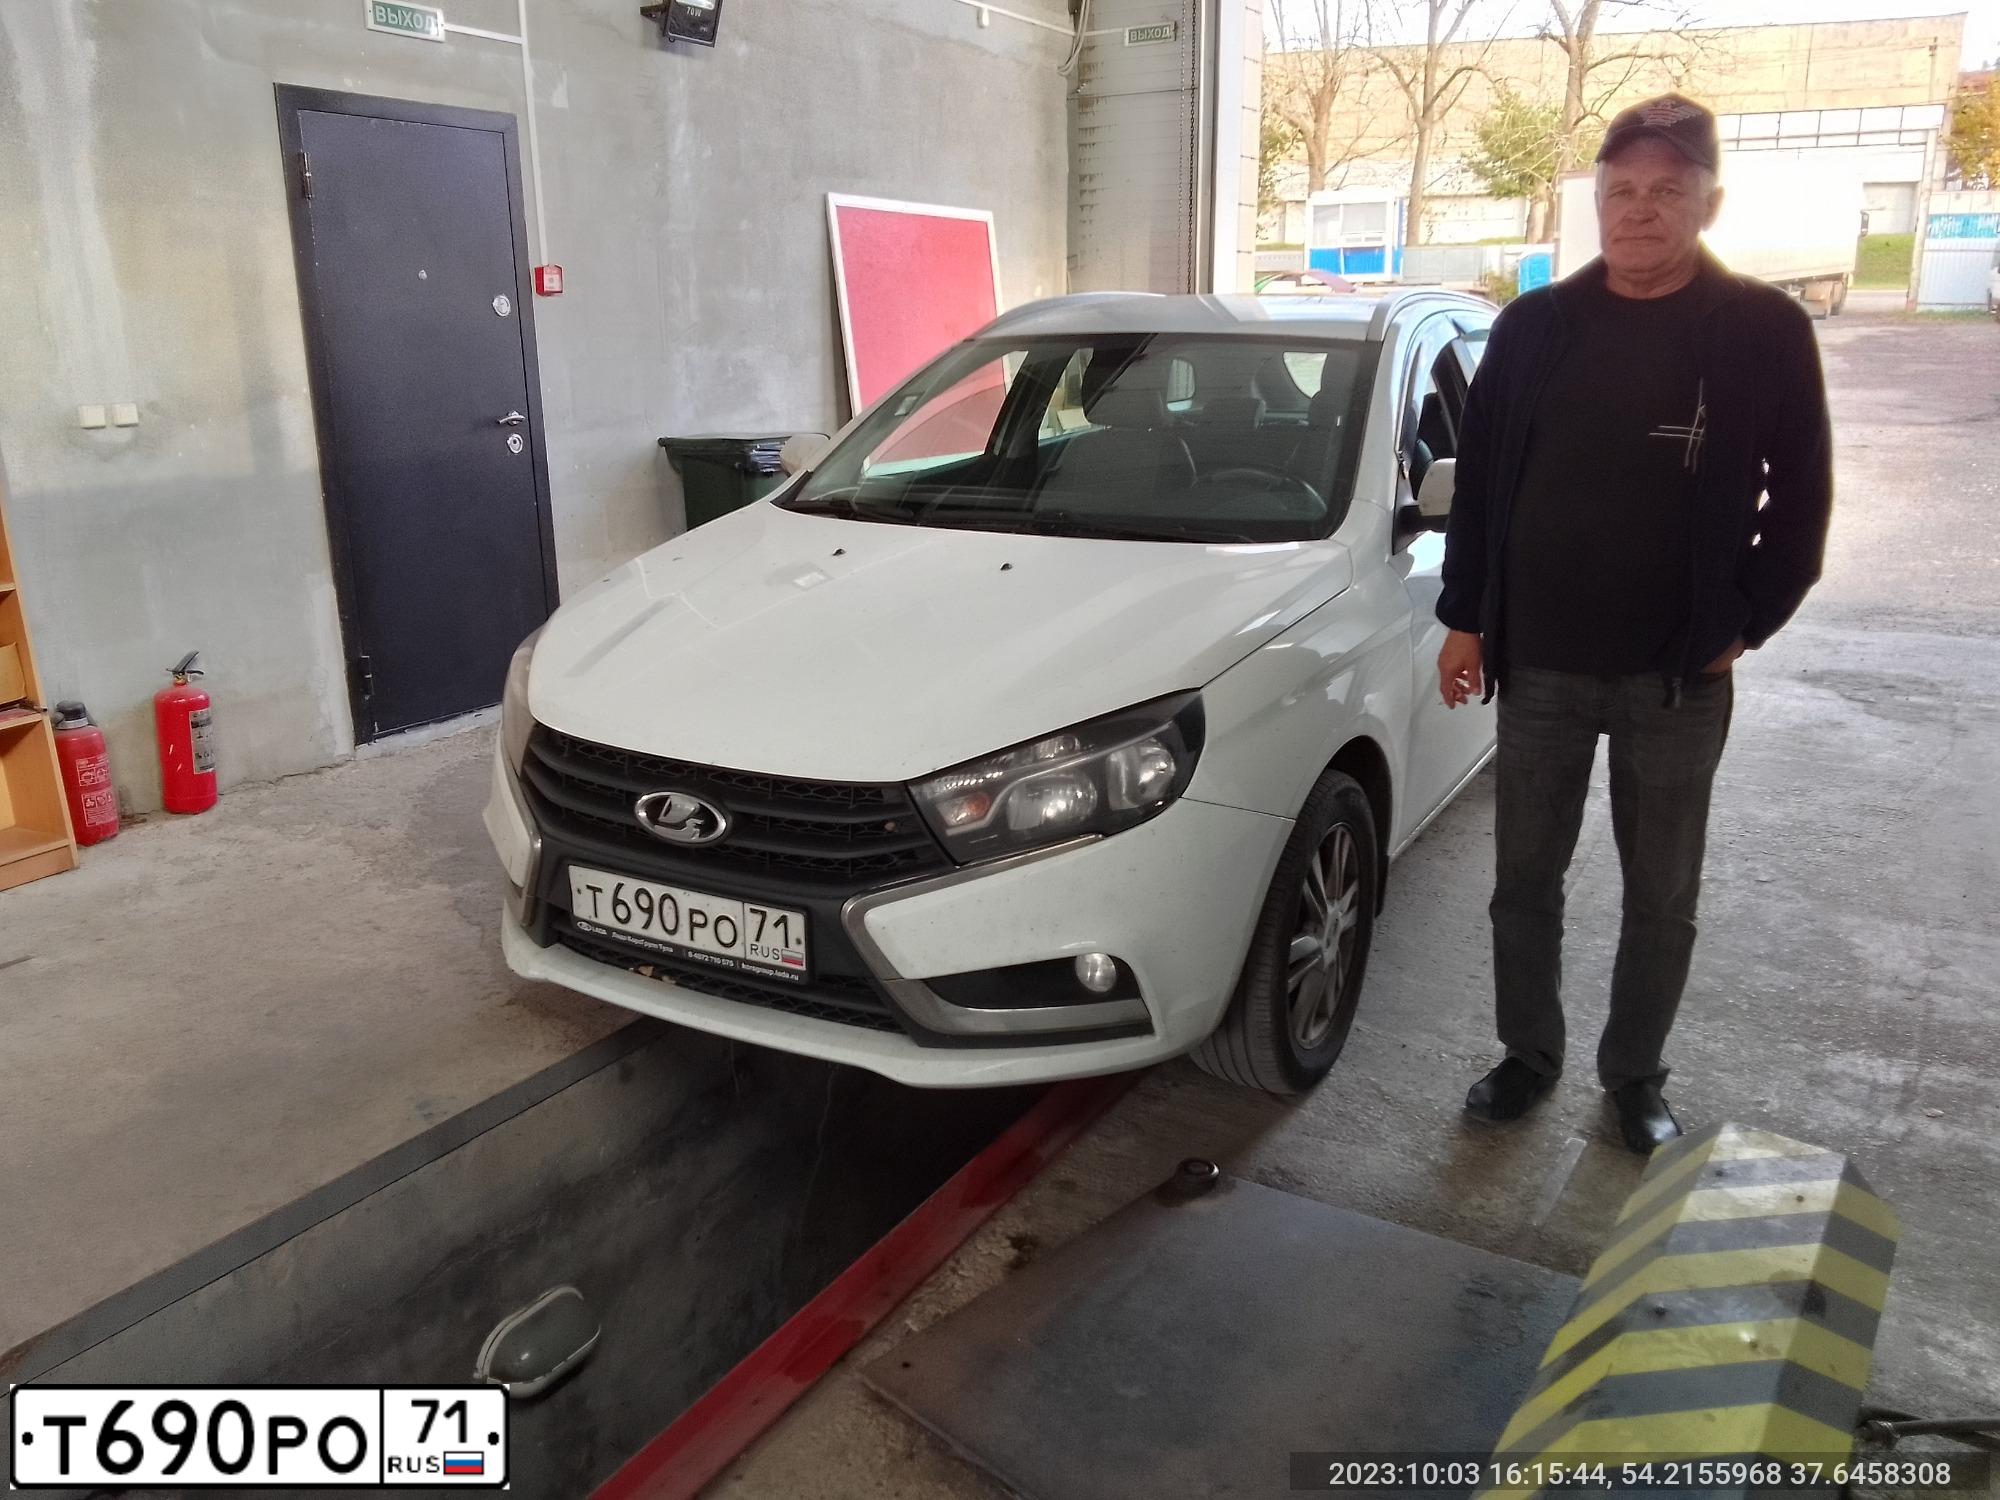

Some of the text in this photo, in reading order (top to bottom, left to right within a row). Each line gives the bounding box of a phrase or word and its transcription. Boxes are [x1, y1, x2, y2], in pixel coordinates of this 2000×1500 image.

[375, 4, 438, 35] ВЫХОД
[686, 6, 702, 17] 70W
[1130, 26, 1170, 41] ВЫХОД
[749, 908, 789, 948] 71
[750, 943, 780, 961] RUS
